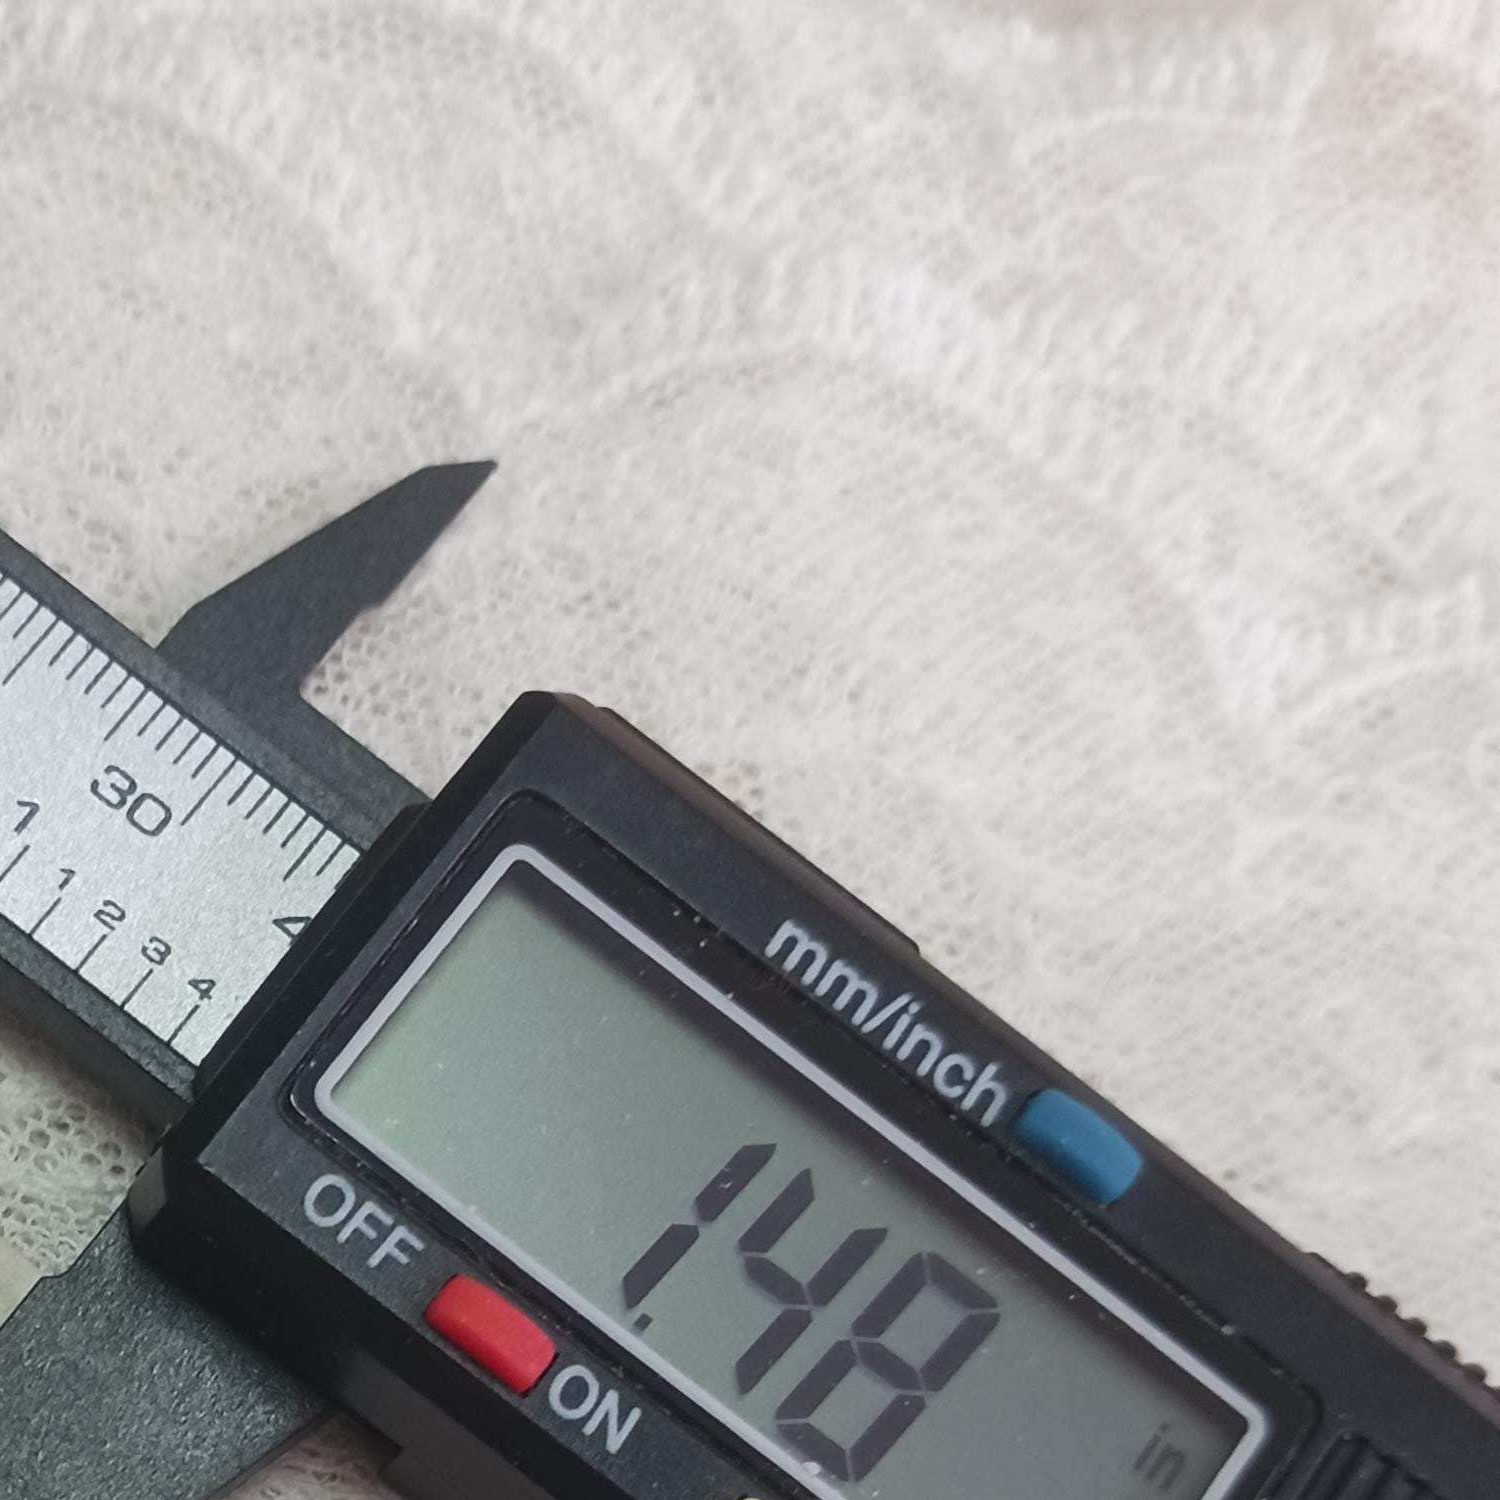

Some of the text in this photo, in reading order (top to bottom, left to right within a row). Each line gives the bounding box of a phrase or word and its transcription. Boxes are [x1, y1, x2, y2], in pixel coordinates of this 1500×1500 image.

[13, 800, 40, 835] 1
[58, 868, 76, 891] 1
[93, 899, 126, 931] 2
[140, 936, 172, 966] 3
[188, 978, 217, 1001] 4
[90, 764, 173, 837] 30
[272, 915, 312, 948] 4
[764, 919, 1007, 1128] mm/inch
[303, 1174, 425, 1269] OFF
[622, 1143, 1001, 1482] 1.48
[549, 1364, 642, 1454] ON
[1132, 1420, 1187, 1492] in
